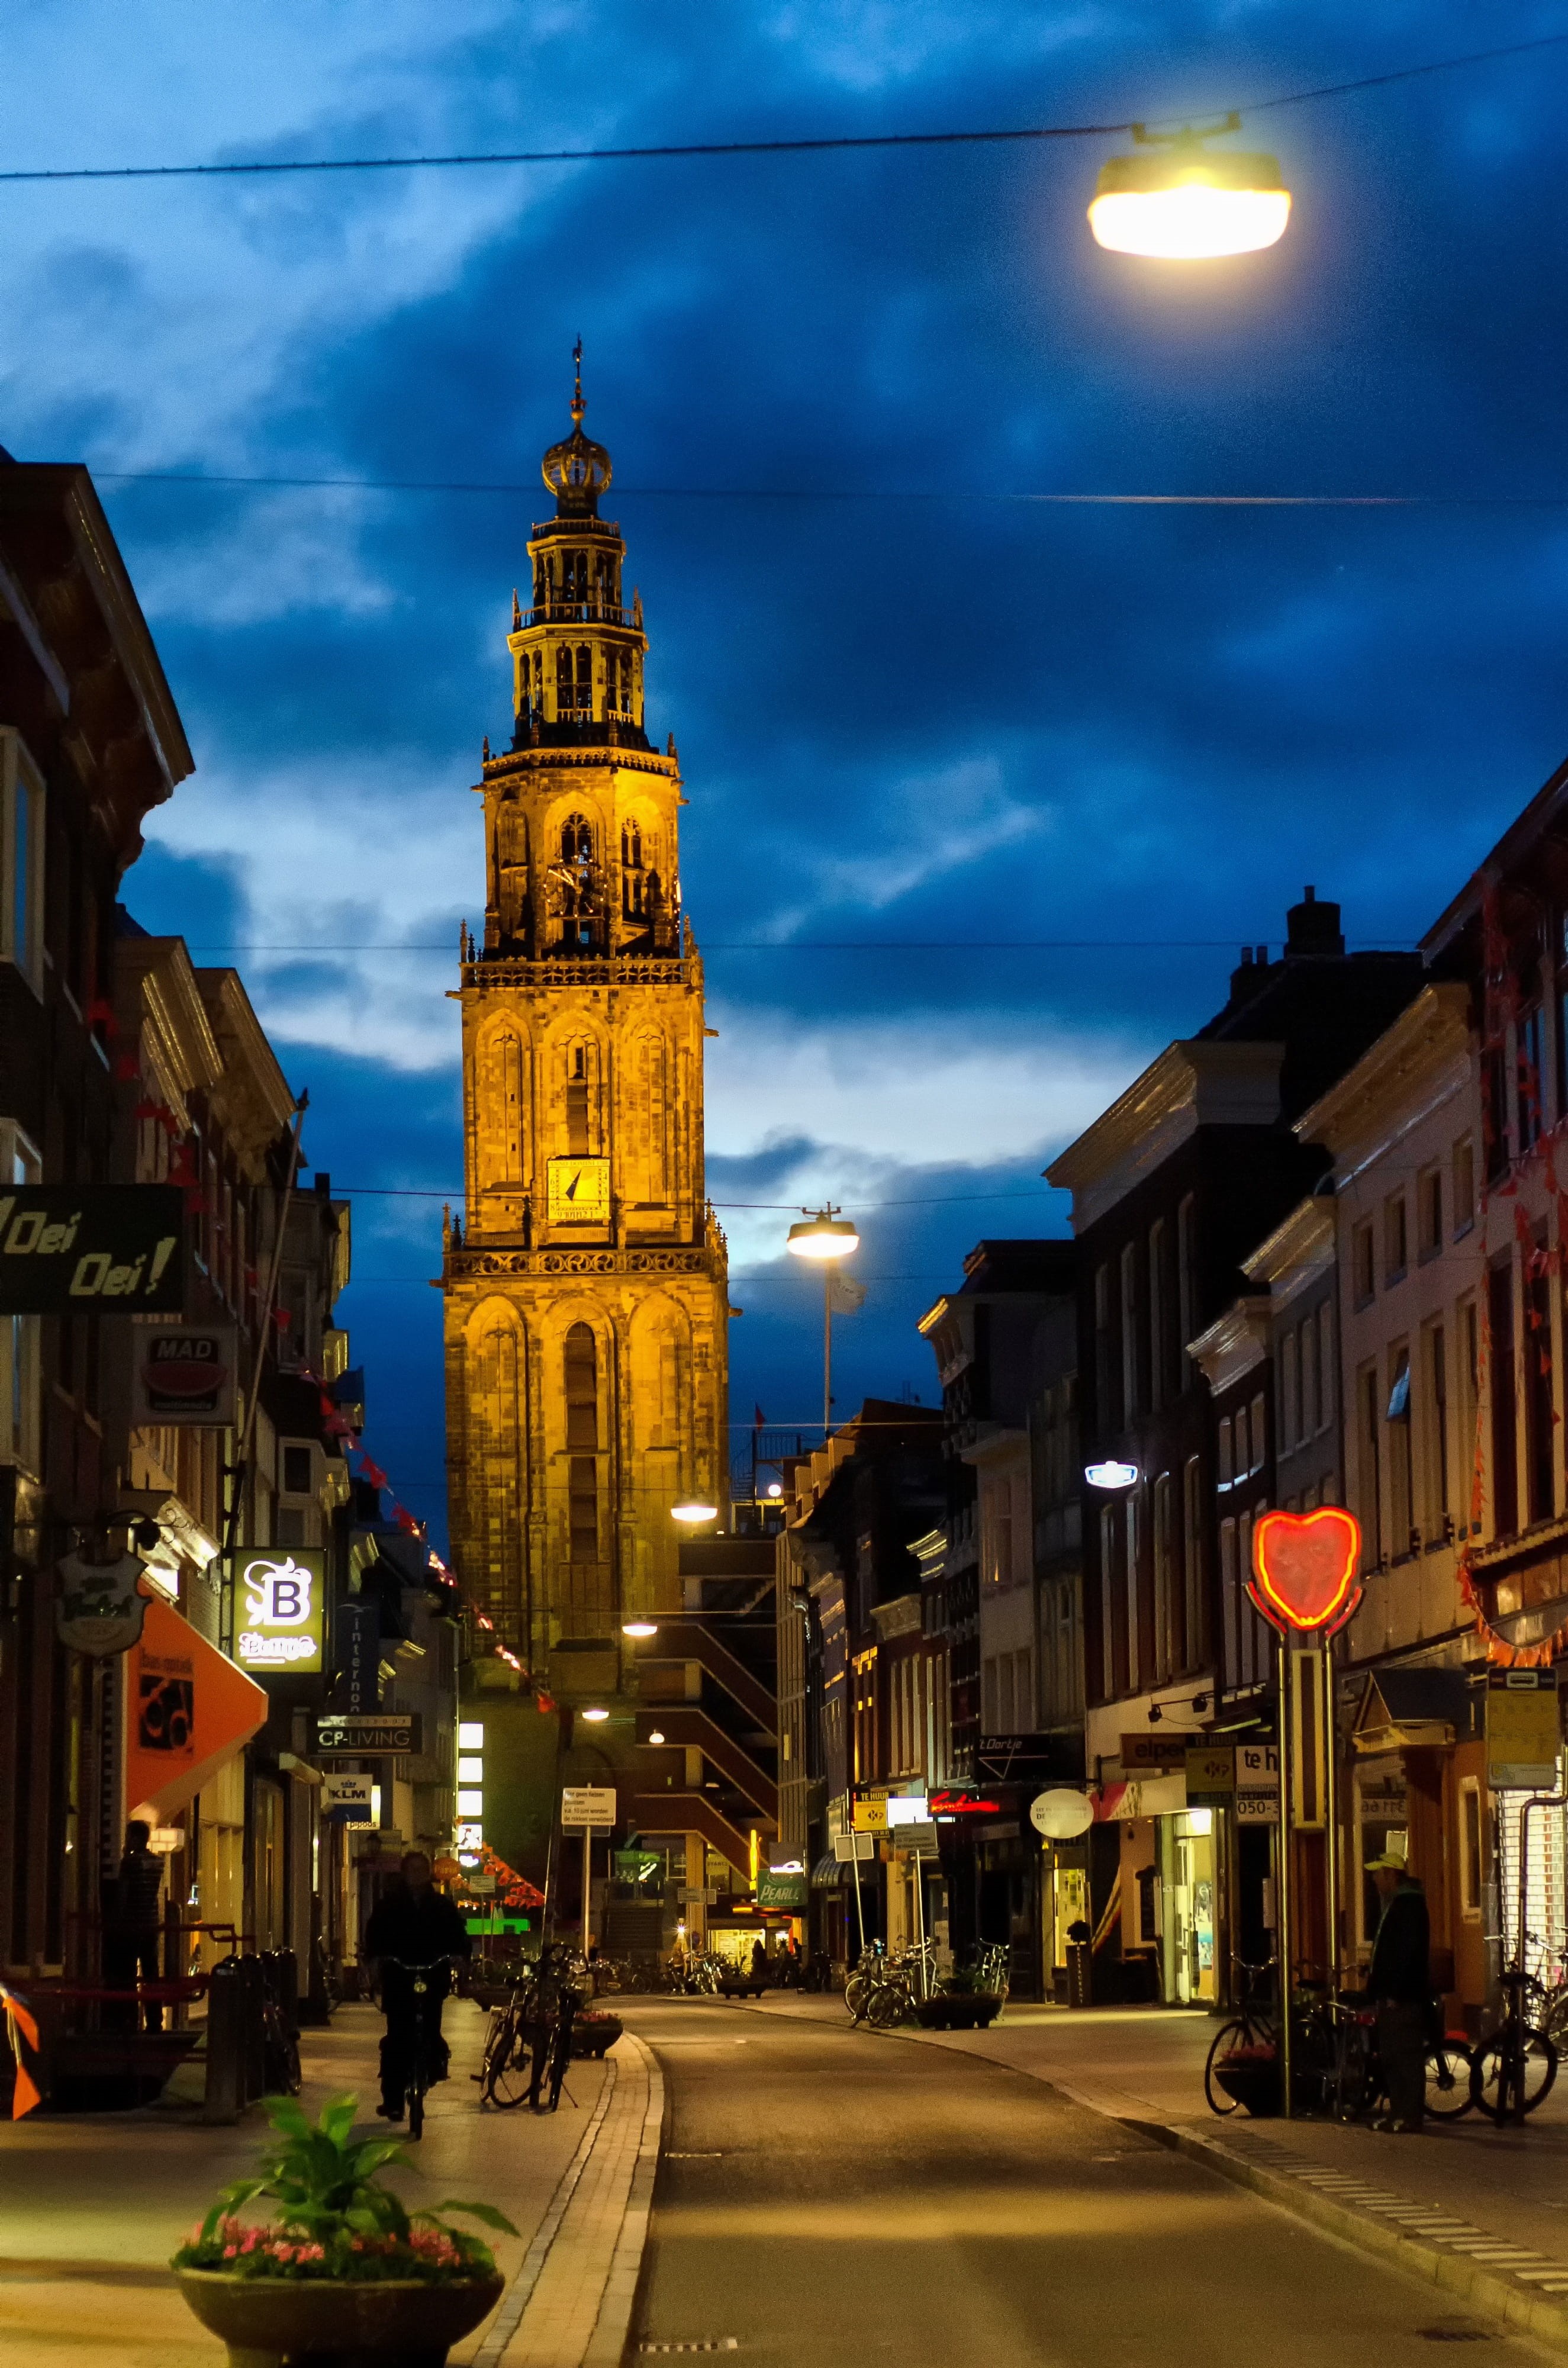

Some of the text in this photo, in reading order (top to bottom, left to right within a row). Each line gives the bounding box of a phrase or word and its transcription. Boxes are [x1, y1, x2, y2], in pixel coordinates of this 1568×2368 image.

[4, 1211, 82, 1254] Oei
[156, 1339, 212, 1359] MAD
[272, 1580, 301, 1618] B
[318, 1730, 410, 1746] CP-LIVING
[1245, 1749, 1260, 1769] te
[329, 1789, 366, 1799] KLM
[861, 1792, 889, 1801] TE HUUR
[1238, 1801, 1279, 1814] 050-3
